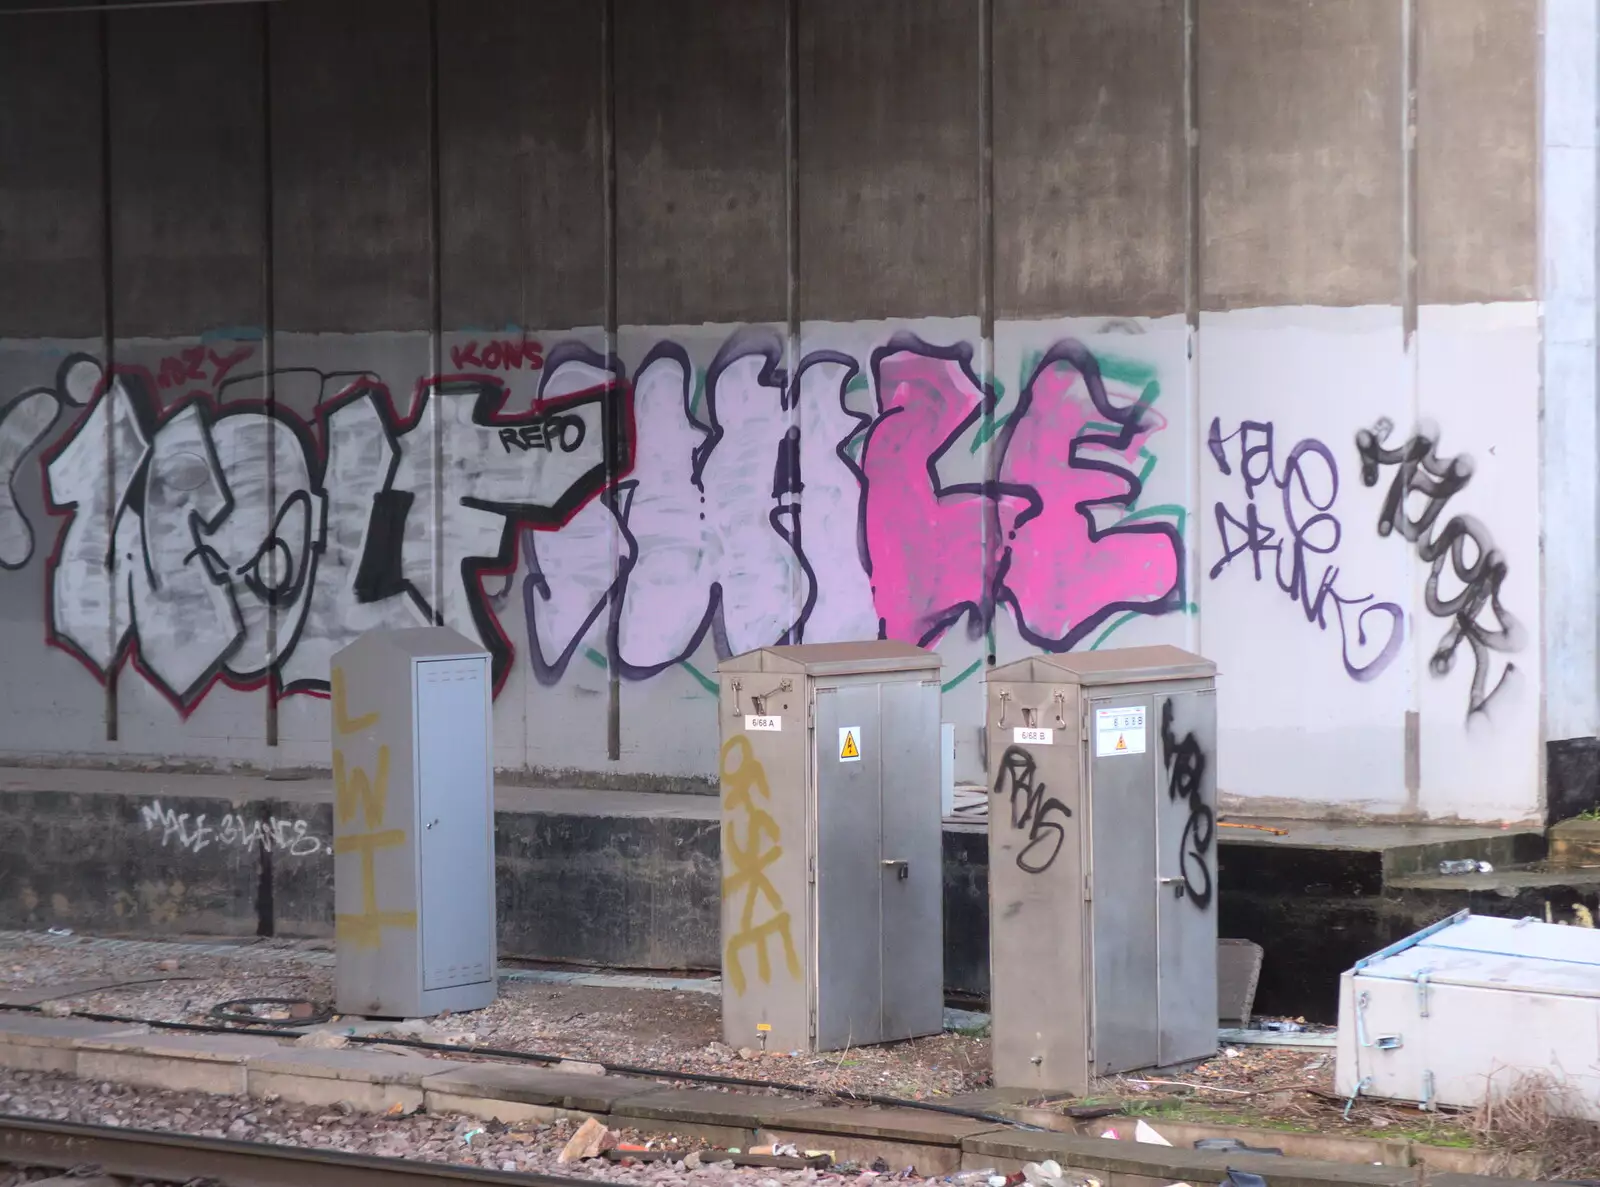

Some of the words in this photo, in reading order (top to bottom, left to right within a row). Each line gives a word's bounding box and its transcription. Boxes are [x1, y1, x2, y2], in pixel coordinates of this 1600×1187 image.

[499, 413, 587, 453] REPO
[752, 719, 767, 727] 6/68
[769, 719, 775, 728] A
